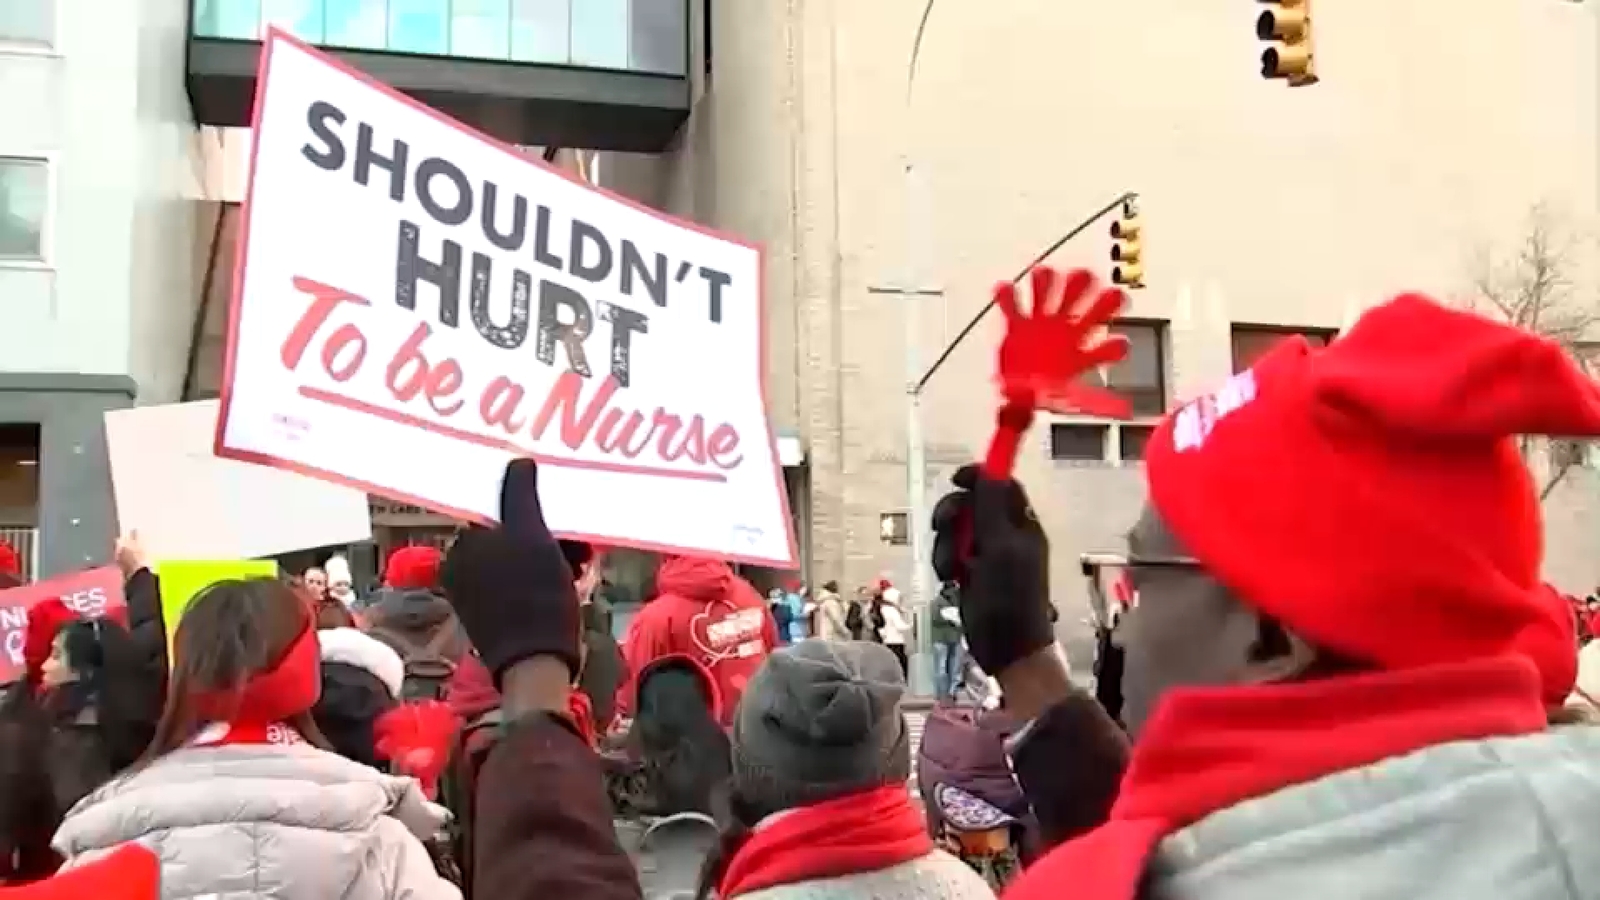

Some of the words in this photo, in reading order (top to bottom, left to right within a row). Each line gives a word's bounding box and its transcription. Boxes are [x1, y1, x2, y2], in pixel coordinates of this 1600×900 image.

[301, 101, 732, 323] SHOULDN'T
[395, 220, 649, 387] HURT
[280, 276, 371, 383] To
[385, 321, 465, 415] be
[478, 375, 525, 434] a
[532, 371, 744, 469] Nurse
